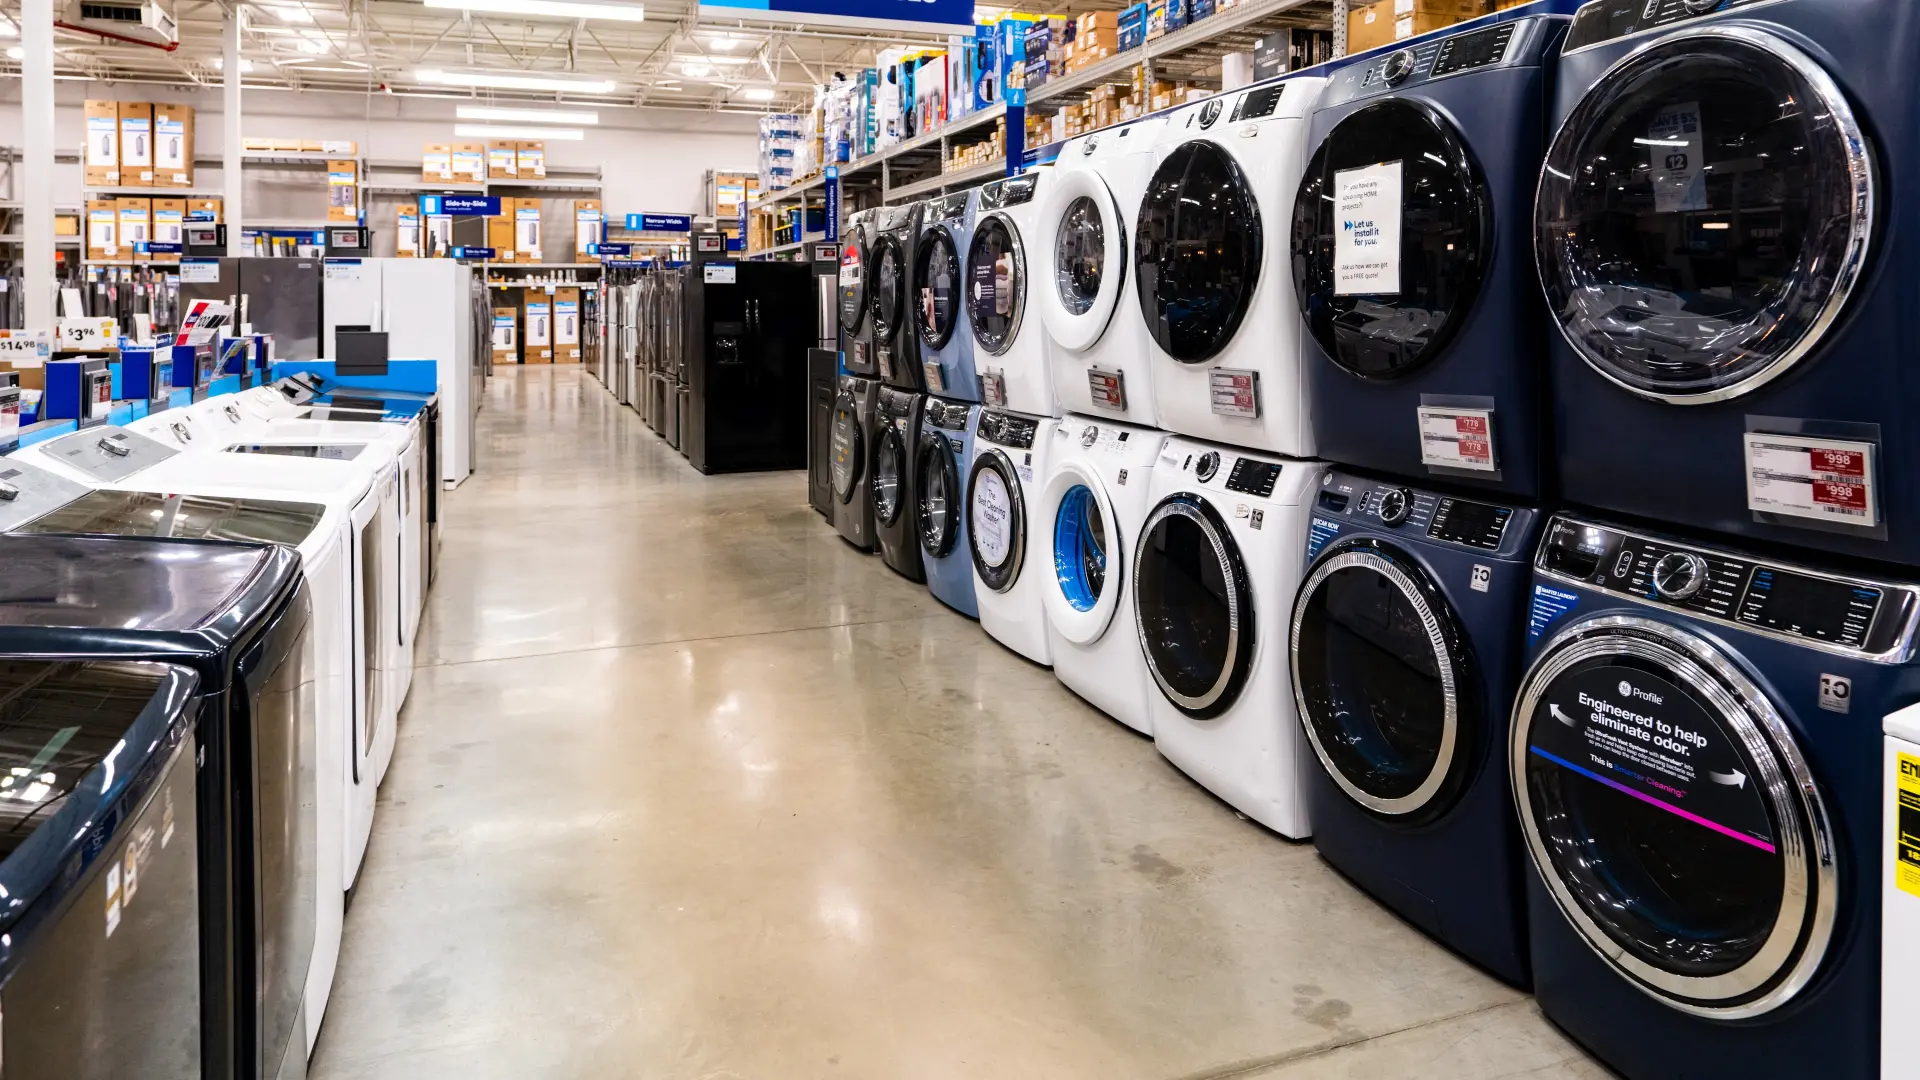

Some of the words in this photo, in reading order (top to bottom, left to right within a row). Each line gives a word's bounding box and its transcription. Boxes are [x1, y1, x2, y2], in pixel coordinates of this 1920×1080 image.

[1668, 156, 1684, 167] 12
[1355, 228, 1373, 237] install
[1354, 238, 1363, 246] for
[1824, 453, 1850, 465] $998
[988, 489, 996, 500] The
[1827, 485, 1852, 497] $998
[978, 495, 986, 507] Best
[987, 500, 1005, 520] Cleaning
[984, 510, 999, 524] Washer
[1328, 522, 1339, 530] NOW
[1610, 629, 1646, 637] ULTRAFRESH
[1646, 634, 1661, 642] VENT
[1579, 692, 1653, 728] Engineered
[1655, 720, 1671, 734] to
[1675, 725, 1707, 748] help
[1590, 712, 1651, 742] eliminate
[1654, 735, 1690, 756] odor.
[1615, 743, 1626, 752] helps
[1666, 762, 1686, 775] bacteria
[1631, 754, 1640, 763] door
[1641, 759, 1655, 769] closed
[1656, 765, 1676, 777] between
[1590, 753, 1606, 766] This
[1607, 760, 1613, 769] is
[1613, 764, 1645, 781] Smarter
